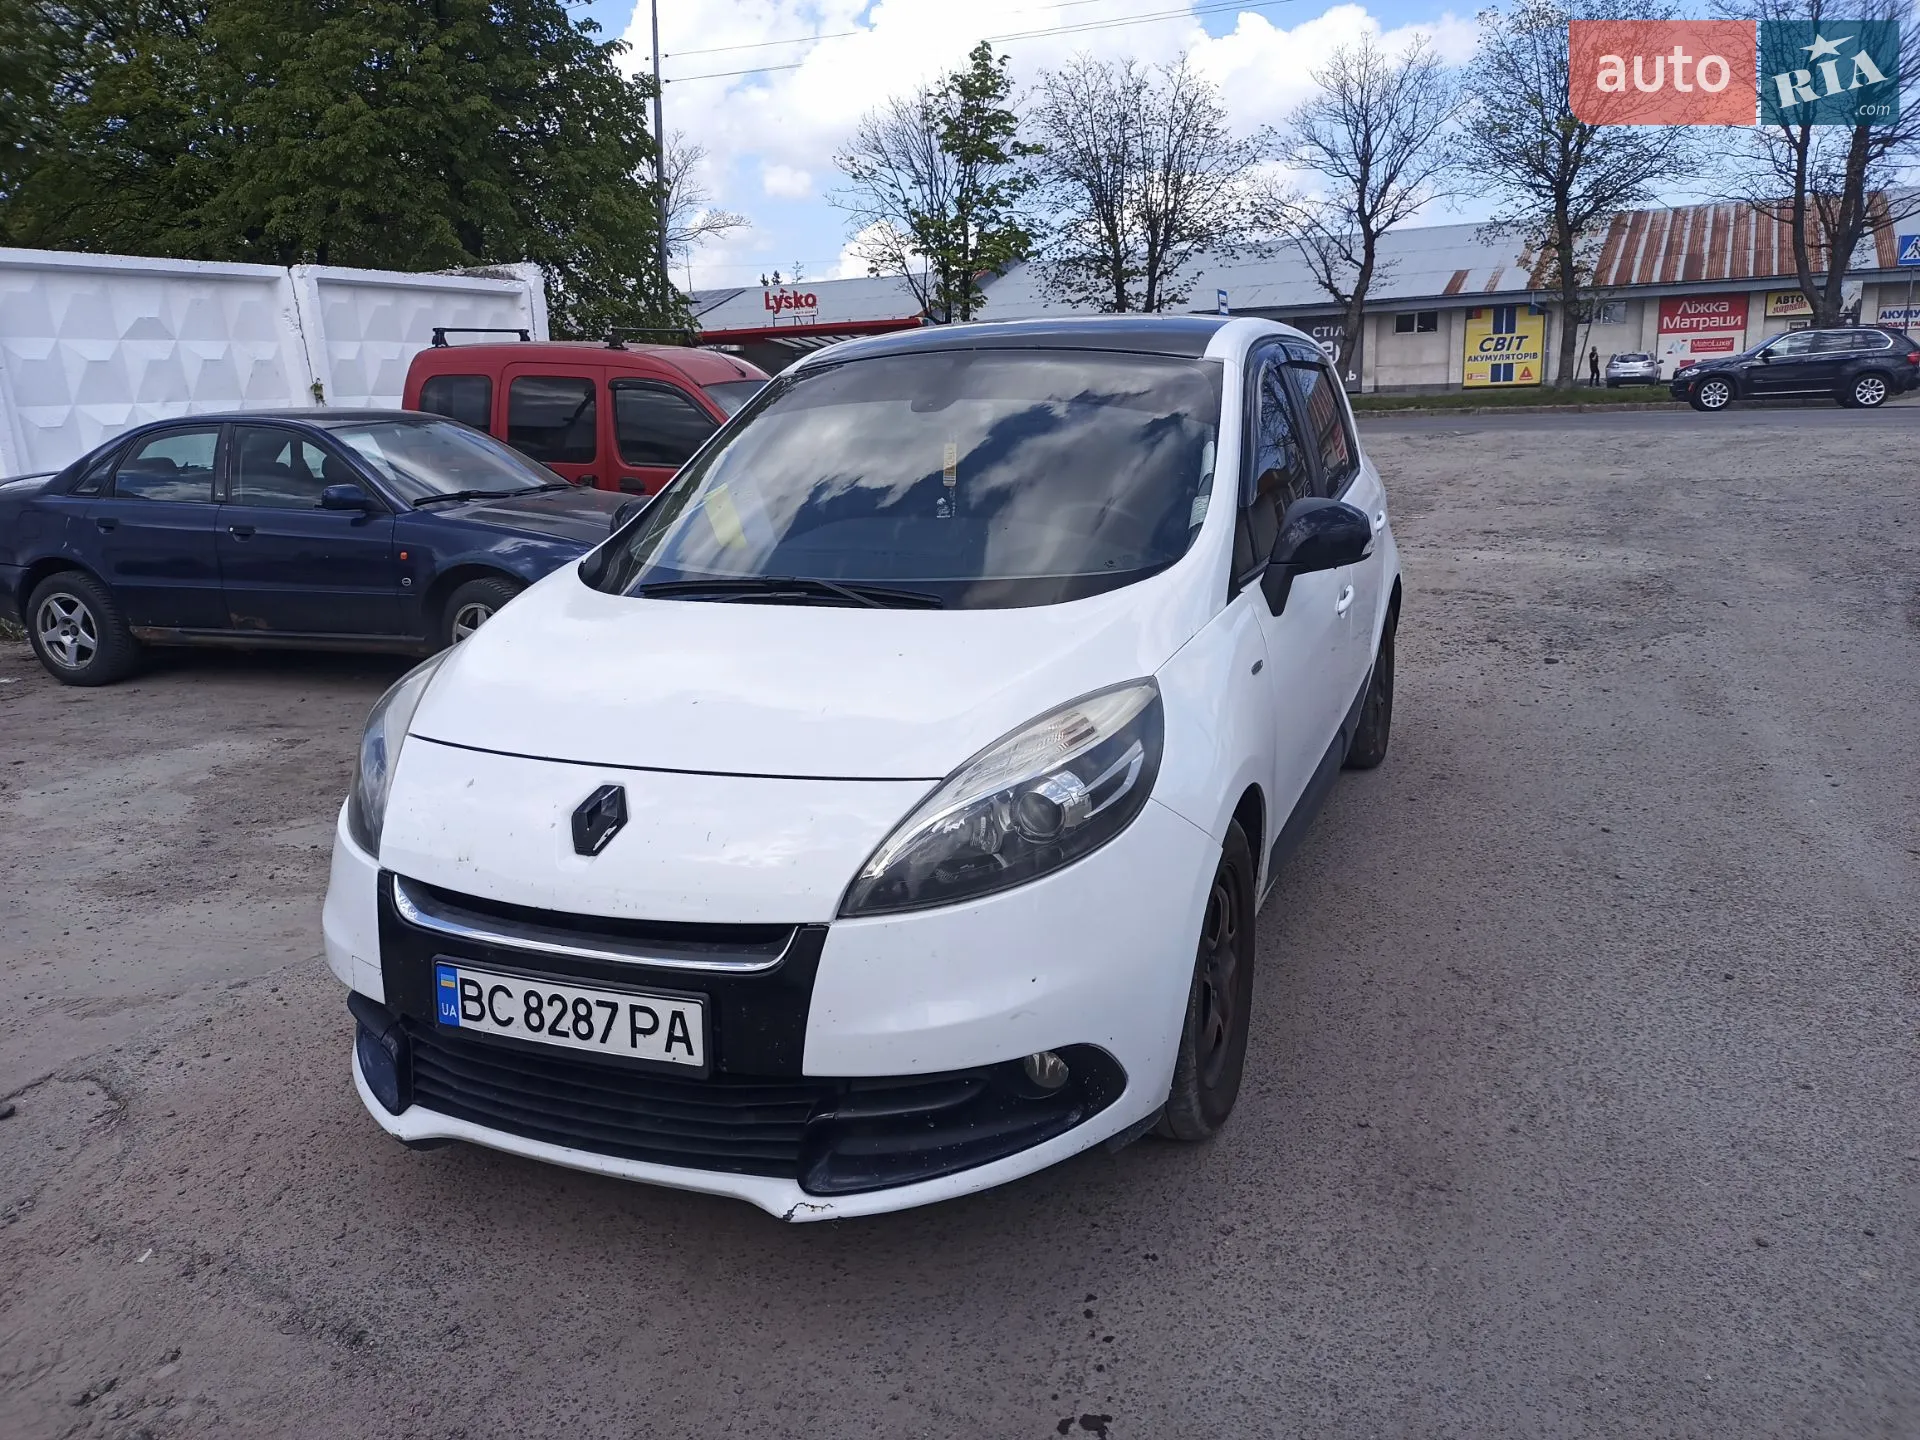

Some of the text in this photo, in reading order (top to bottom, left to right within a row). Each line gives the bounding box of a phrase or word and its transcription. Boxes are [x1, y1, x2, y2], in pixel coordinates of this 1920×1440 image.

[765, 289, 816, 314] Lysko
[1775, 295, 1804, 304] АВТО
[1677, 301, 1729, 314] Ліжка
[1663, 316, 1741, 330] Матраци
[1479, 336, 1528, 352] СВІТ
[1467, 352, 1538, 362] АКУМУЛЯТОРІВ
[441, 1002, 457, 1018] UA
[459, 977, 694, 1056] BC 8287 PA
